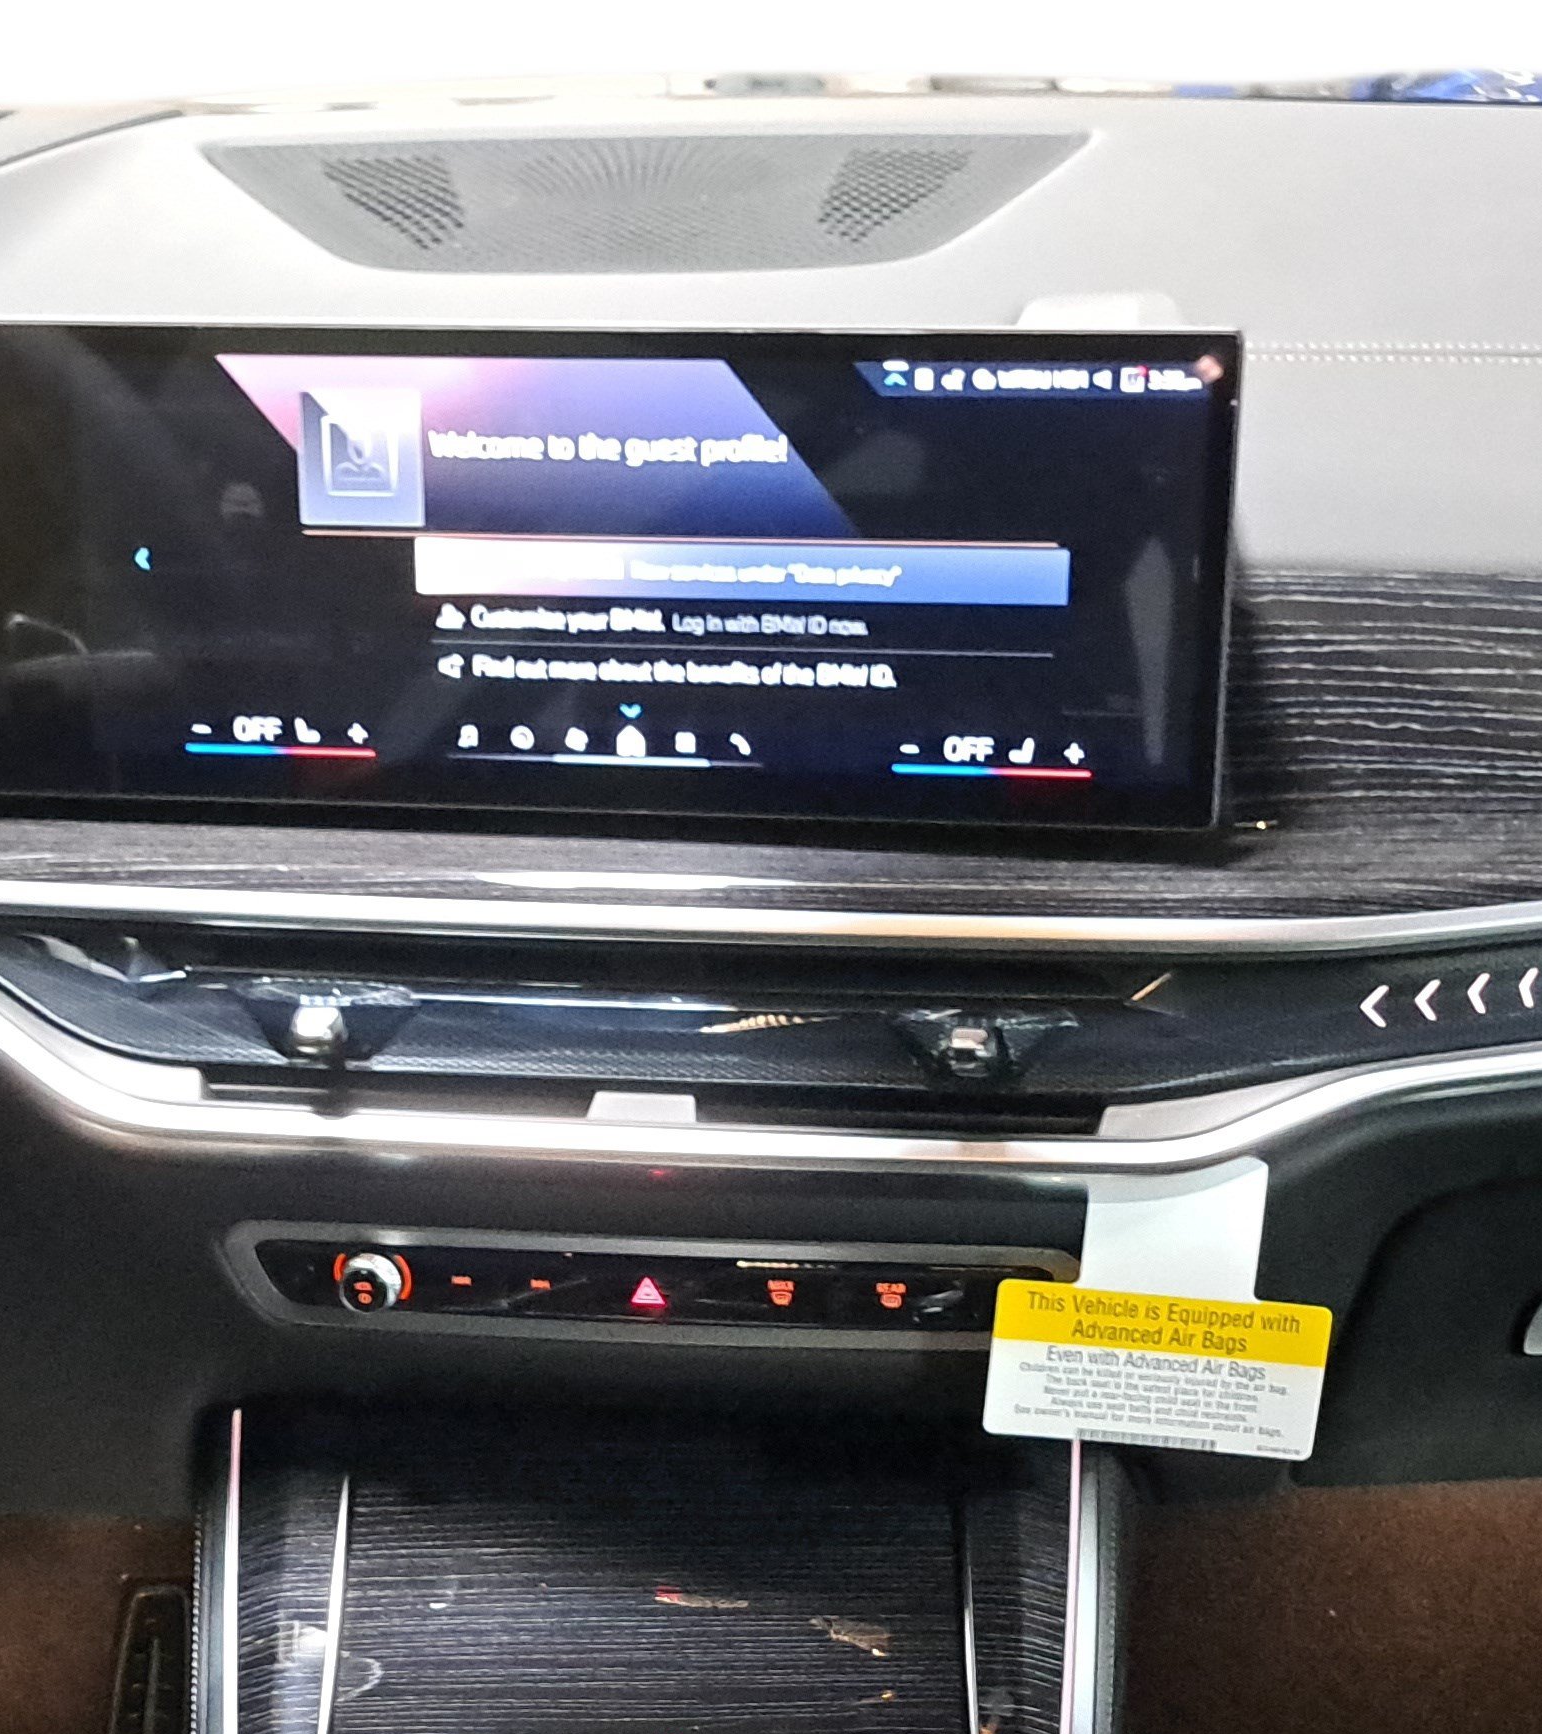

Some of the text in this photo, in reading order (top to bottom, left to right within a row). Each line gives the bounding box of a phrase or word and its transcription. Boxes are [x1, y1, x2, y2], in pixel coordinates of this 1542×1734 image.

[427, 430, 545, 460] Welcome
[547, 434, 576, 461] to
[578, 432, 622, 462] the
[624, 437, 698, 467] guest
[672, 612, 705, 637] Log
[706, 614, 723, 634] in
[724, 614, 759, 634] with
[760, 613, 806, 635] BMW
[472, 653, 515, 679] Find
[515, 657, 549, 681] out
[549, 661, 597, 682] more
[598, 657, 653, 683] about
[653, 659, 686, 683] the
[761, 661, 782, 686] of
[782, 662, 815, 687] the
[816, 662, 869, 688] BMW
[232, 715, 283, 742] OFF
[943, 736, 995, 762] OFF
[1028, 1291, 1301, 1334] This Vehicle is Equipped with
[1071, 1319, 1248, 1355] Advanced Air Bags
[1046, 1345, 1083, 1363] Even
[1087, 1349, 1120, 1366] with
[1123, 1351, 1199, 1374] Advanced
[1202, 1360, 1225, 1376] Air
[1227, 1360, 1267, 1382] Bags
